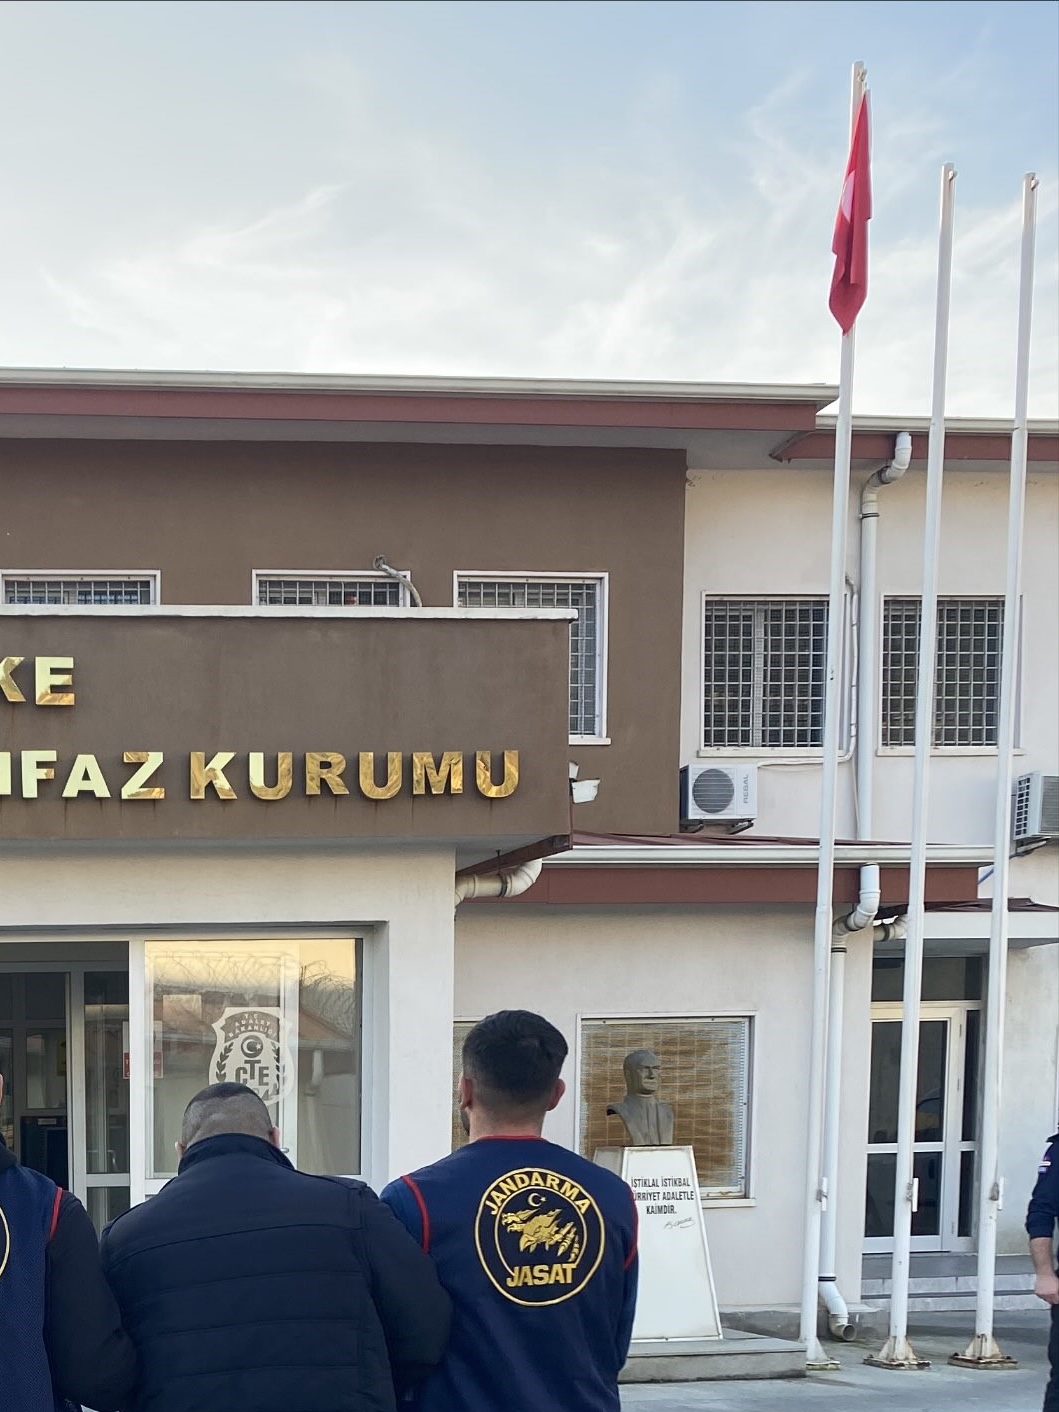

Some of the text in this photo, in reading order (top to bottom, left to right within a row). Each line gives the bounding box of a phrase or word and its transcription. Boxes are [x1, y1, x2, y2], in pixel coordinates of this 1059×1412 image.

[189, 749, 520, 800] KURUMU
[235, 1059, 270, 1087] CTE
[484, 1171, 592, 1217] JANDARMA
[662, 1191, 694, 1201] ADALETLE
[506, 1263, 577, 1288] JASAT
